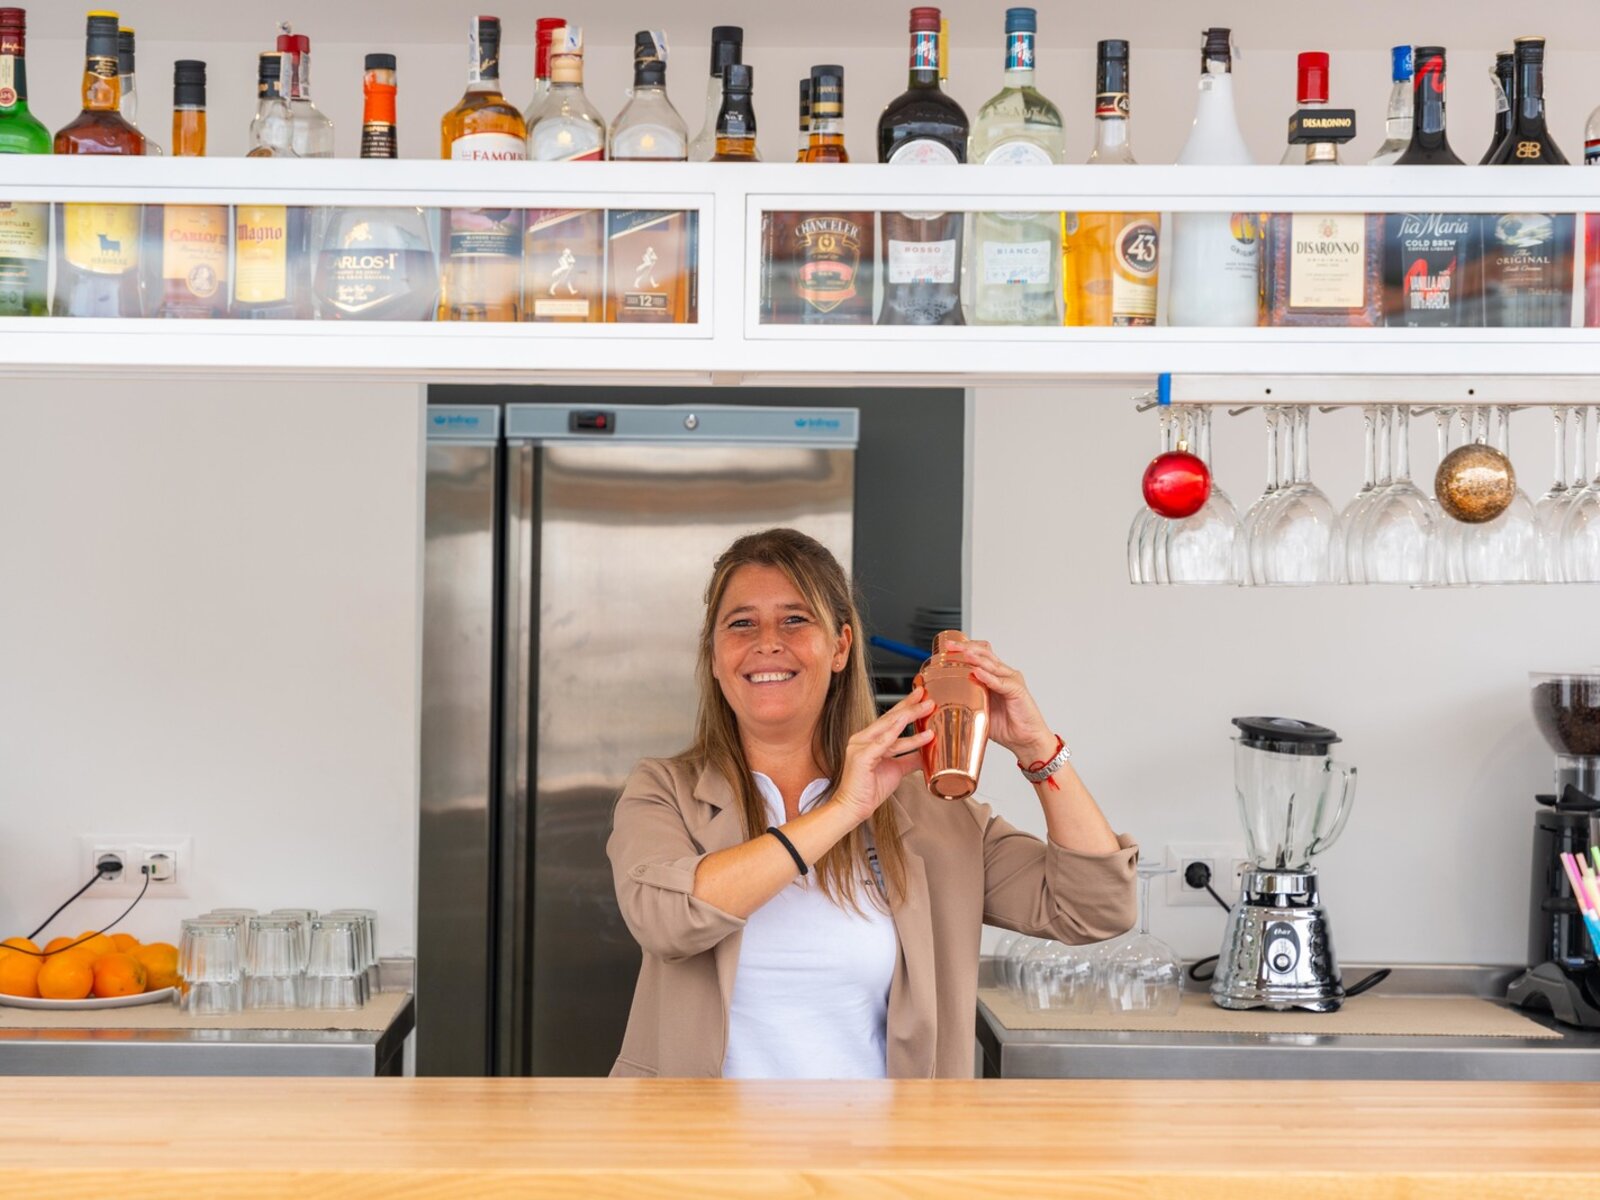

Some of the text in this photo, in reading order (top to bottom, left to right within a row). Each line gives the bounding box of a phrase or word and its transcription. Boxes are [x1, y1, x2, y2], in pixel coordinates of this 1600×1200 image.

[1303, 118, 1352, 128] DISARONNO
[237, 224, 282, 244] Magno
[795, 219, 859, 238] CHANCELER
[169, 229, 217, 243] CARLOS
[904, 246, 942, 254] ROSSO
[1127, 234, 1157, 262] 43
[1296, 241, 1360, 256] DISARONNO
[1495, 256, 1550, 265] ORIGINAL
[639, 295, 653, 308] 12
